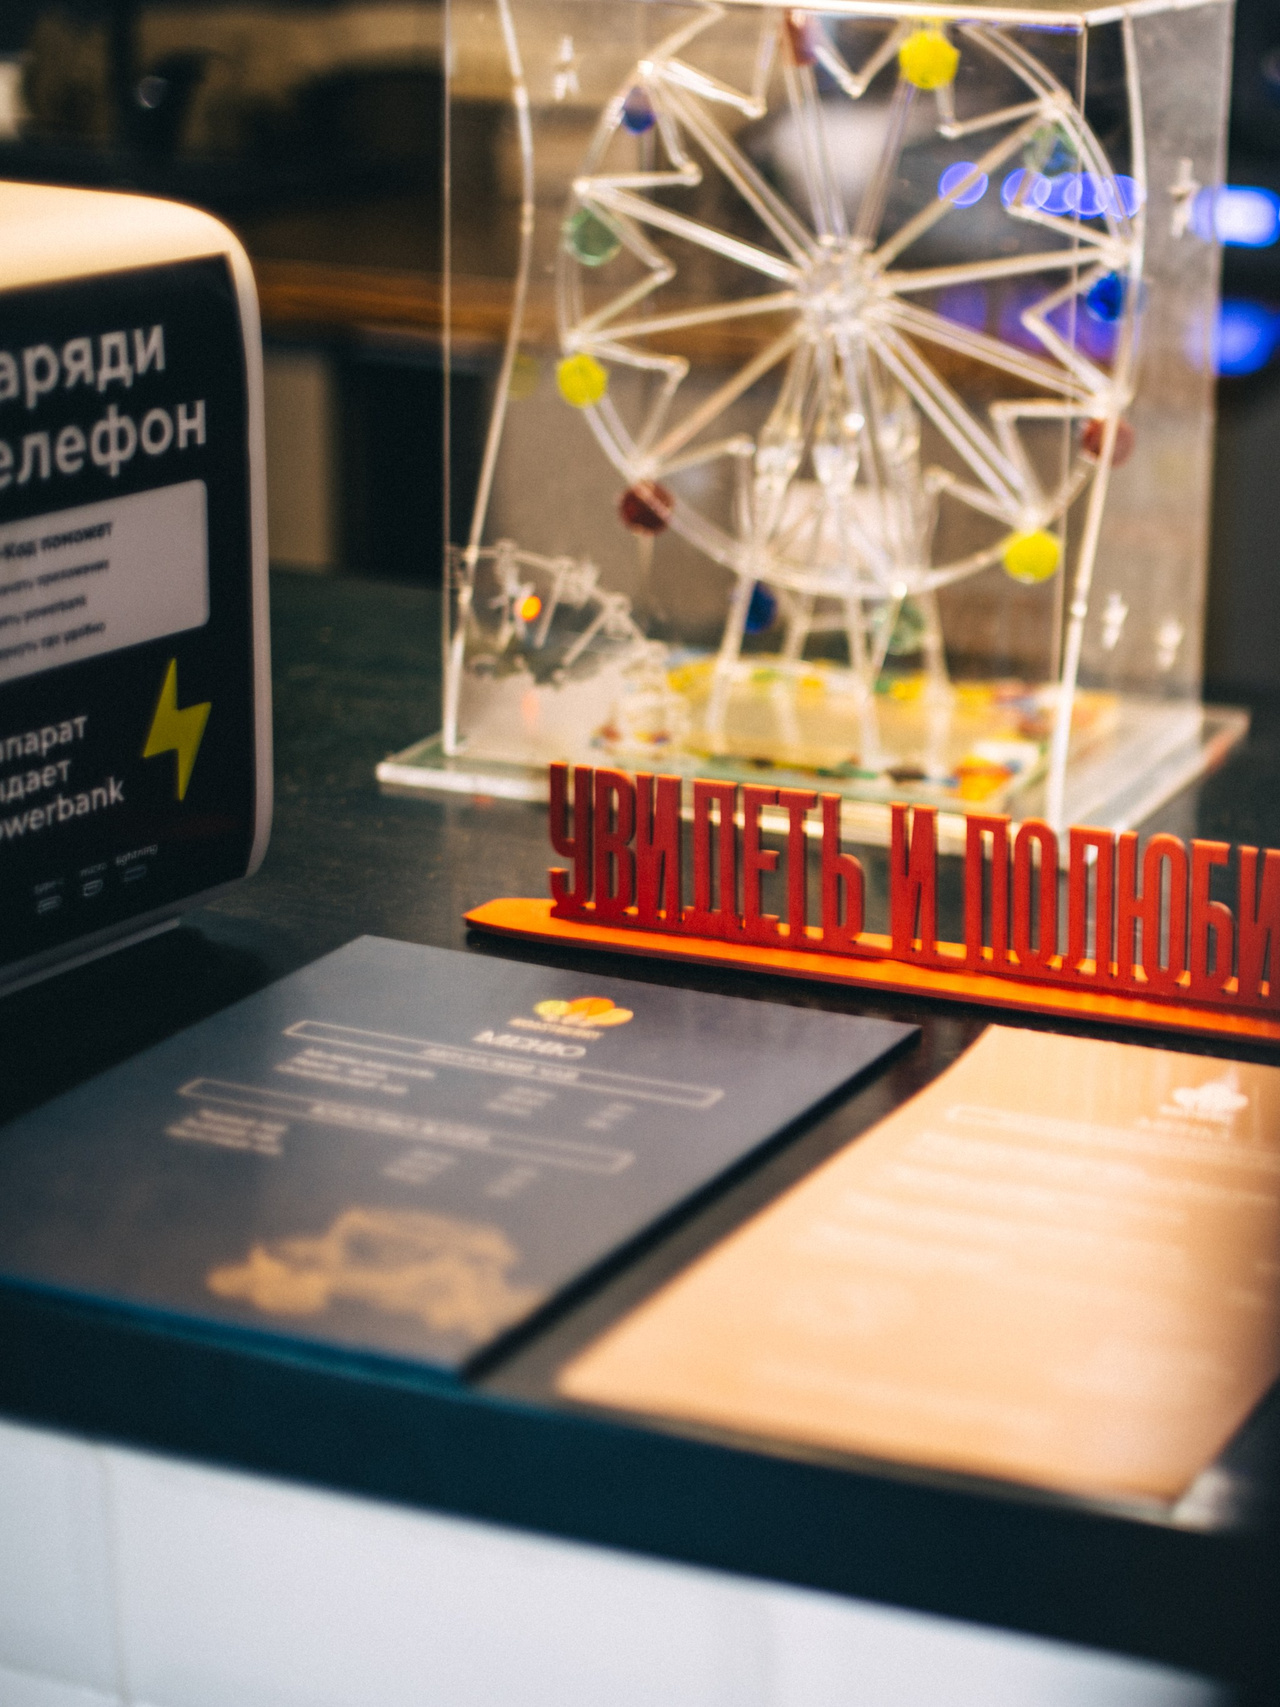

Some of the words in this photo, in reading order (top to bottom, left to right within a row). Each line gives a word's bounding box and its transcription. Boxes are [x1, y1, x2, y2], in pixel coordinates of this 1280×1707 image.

[0, 324, 166, 411] аряди
[0, 715, 88, 761] парат
[0, 776, 124, 841] werbank
[548, 762, 866, 948] УВИДЕТЬ
[889, 801, 939, 958] И
